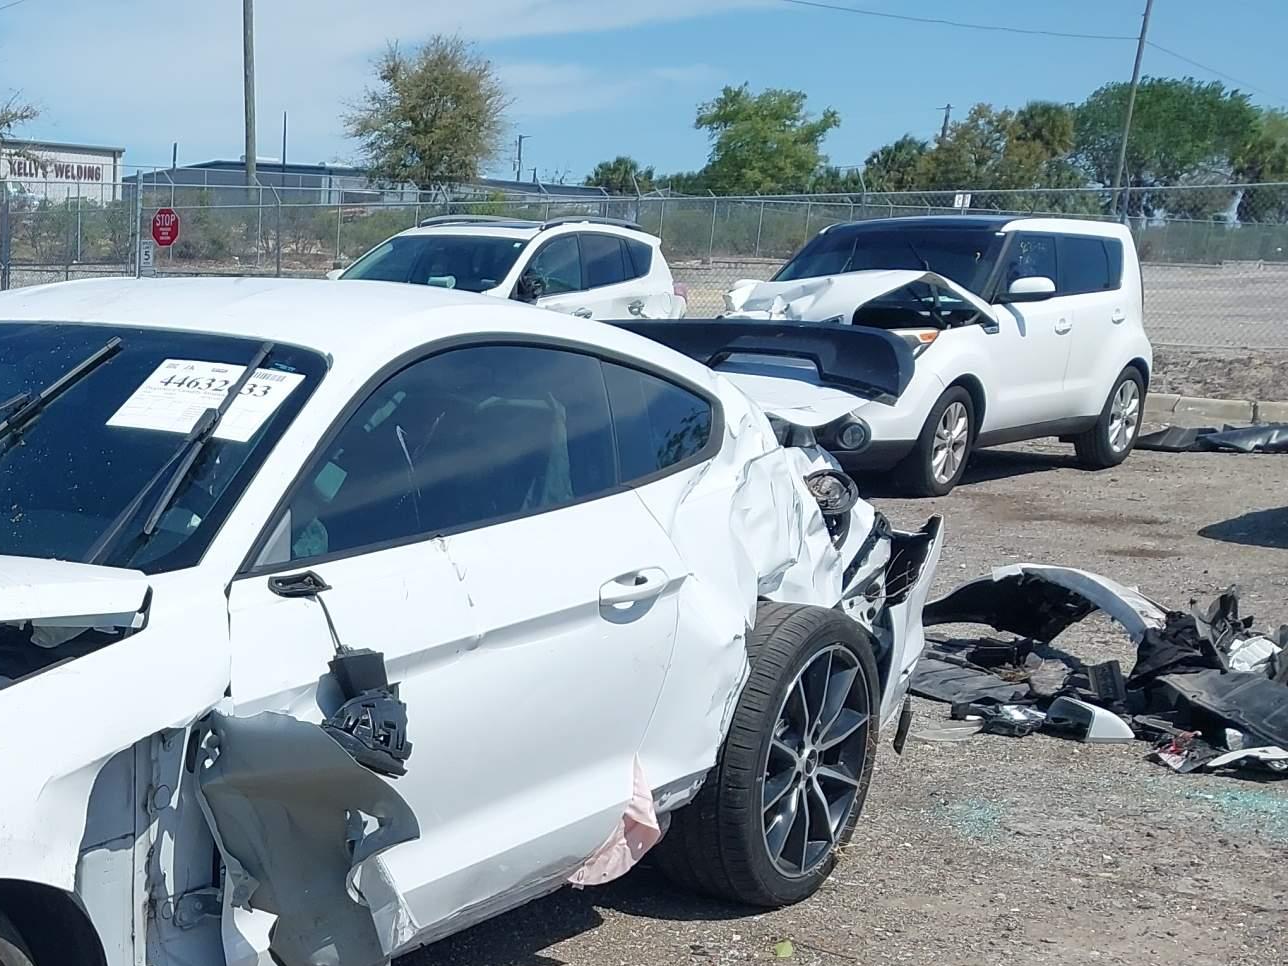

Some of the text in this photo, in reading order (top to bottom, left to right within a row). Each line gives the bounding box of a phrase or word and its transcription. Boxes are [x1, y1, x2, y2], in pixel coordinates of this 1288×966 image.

[8, 159, 101, 181] KELLYS WELDING
[155, 213, 176, 226] STOP
[143, 250, 151, 261] 5
[159, 374, 272, 397] 4463233
